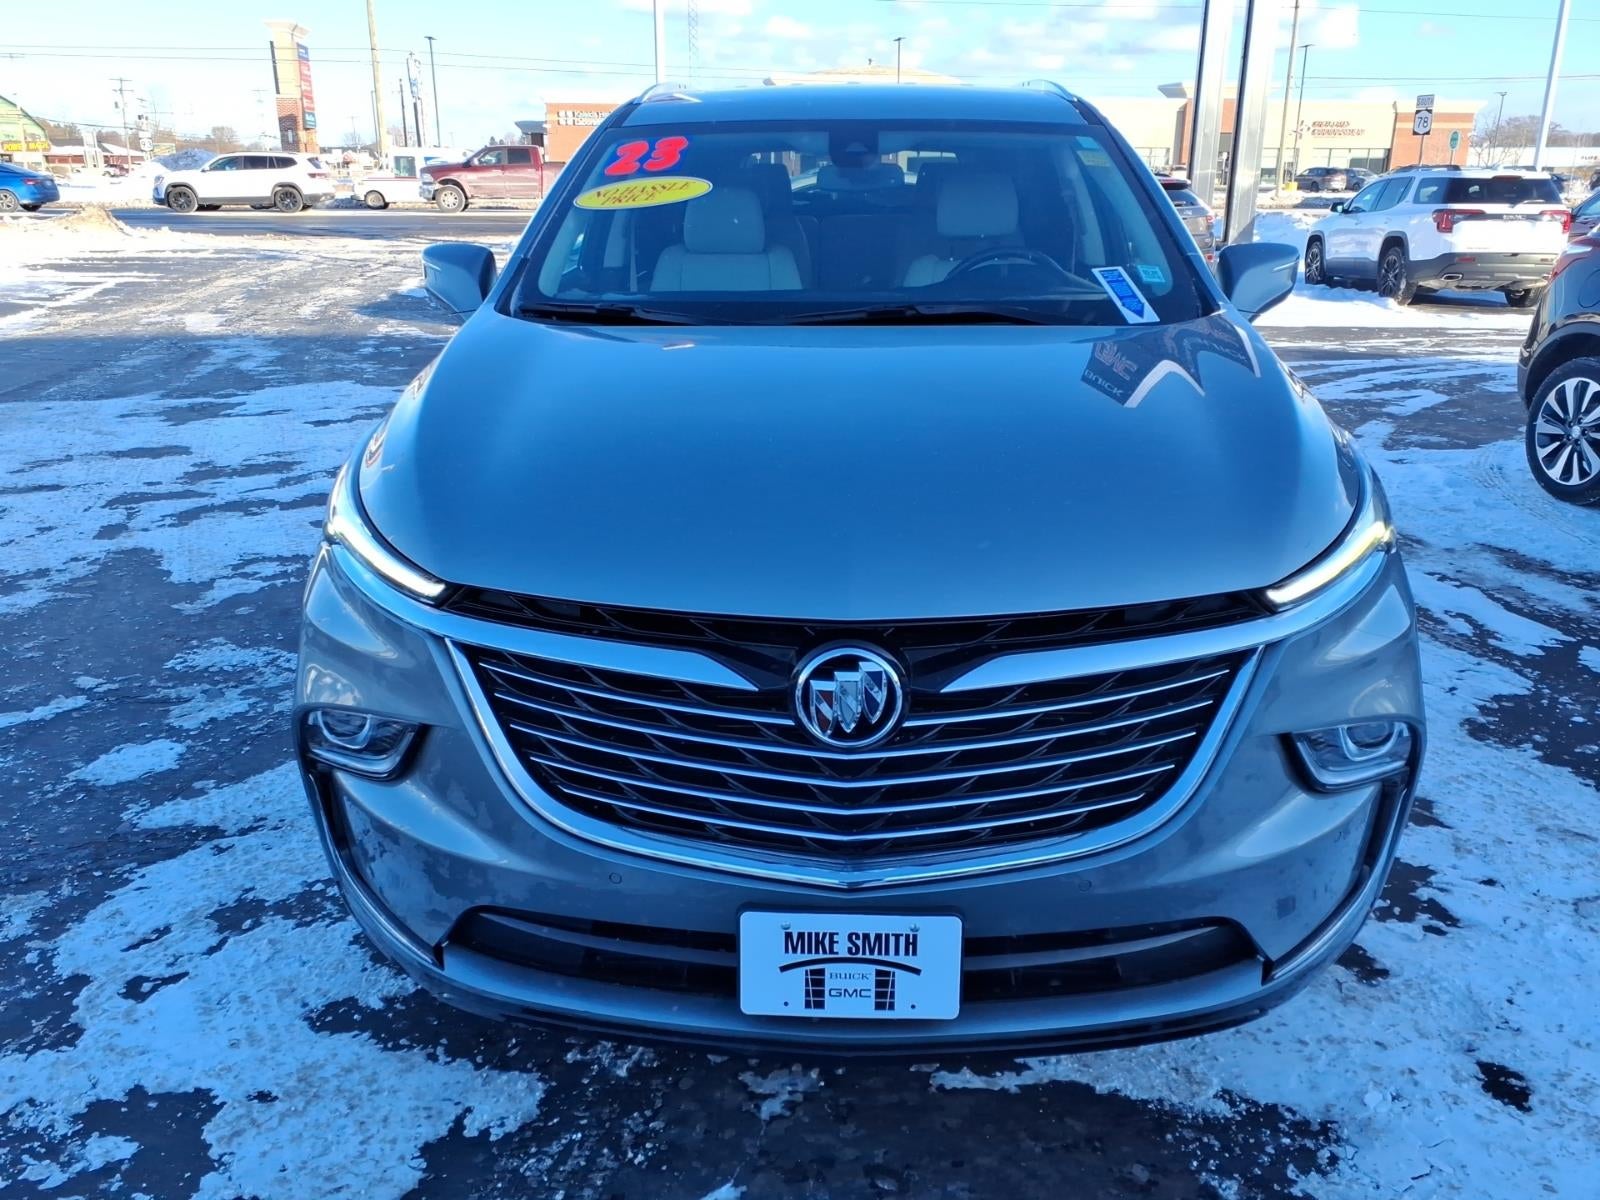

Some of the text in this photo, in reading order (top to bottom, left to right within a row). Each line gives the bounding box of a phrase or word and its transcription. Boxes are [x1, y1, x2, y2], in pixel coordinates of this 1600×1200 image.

[1416, 97, 1433, 106] SOUTH
[1417, 116, 1429, 128] 78
[604, 136, 689, 176] 23
[784, 931, 918, 957] MIKE SMITH
[829, 971, 871, 981] BUICK
[828, 987, 872, 998] GMC
